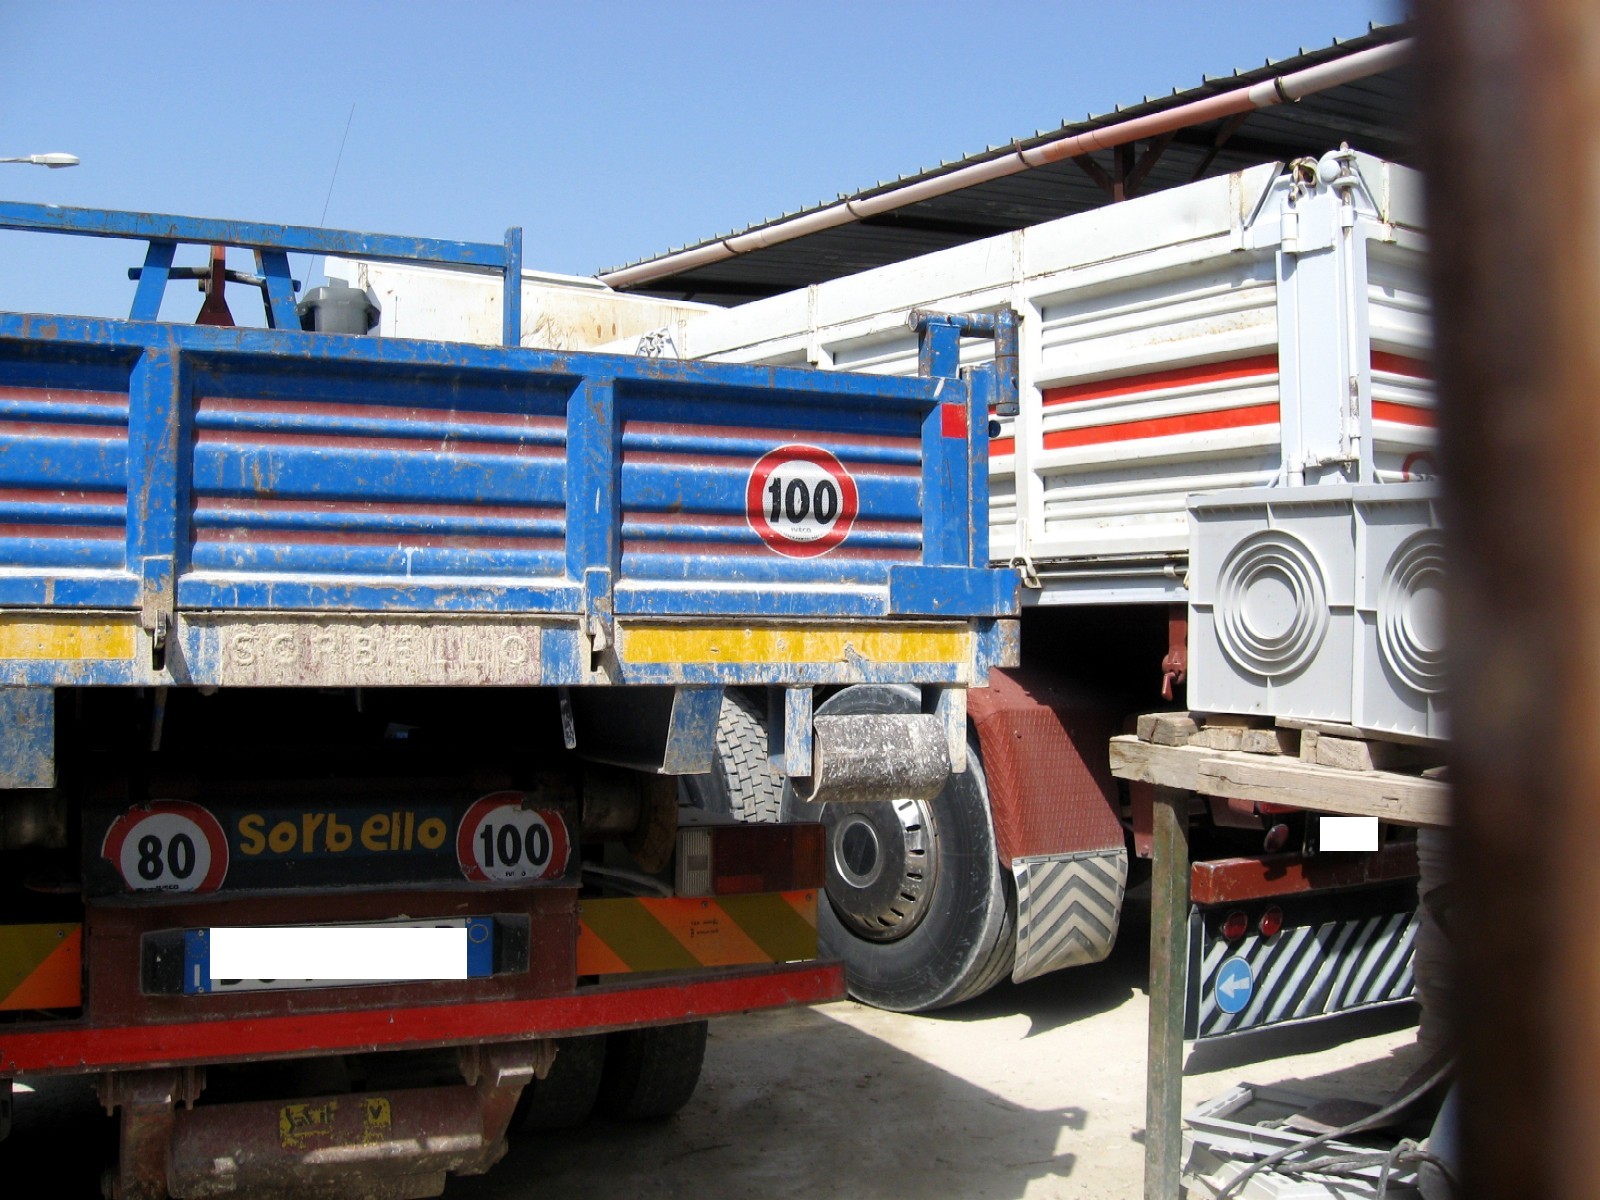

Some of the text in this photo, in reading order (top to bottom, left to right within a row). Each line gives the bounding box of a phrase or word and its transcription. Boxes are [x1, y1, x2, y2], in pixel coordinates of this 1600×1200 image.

[769, 477, 837, 524] 100
[237, 812, 447, 855] Sorbello
[480, 823, 549, 867] 100
[138, 833, 195, 880] 80
